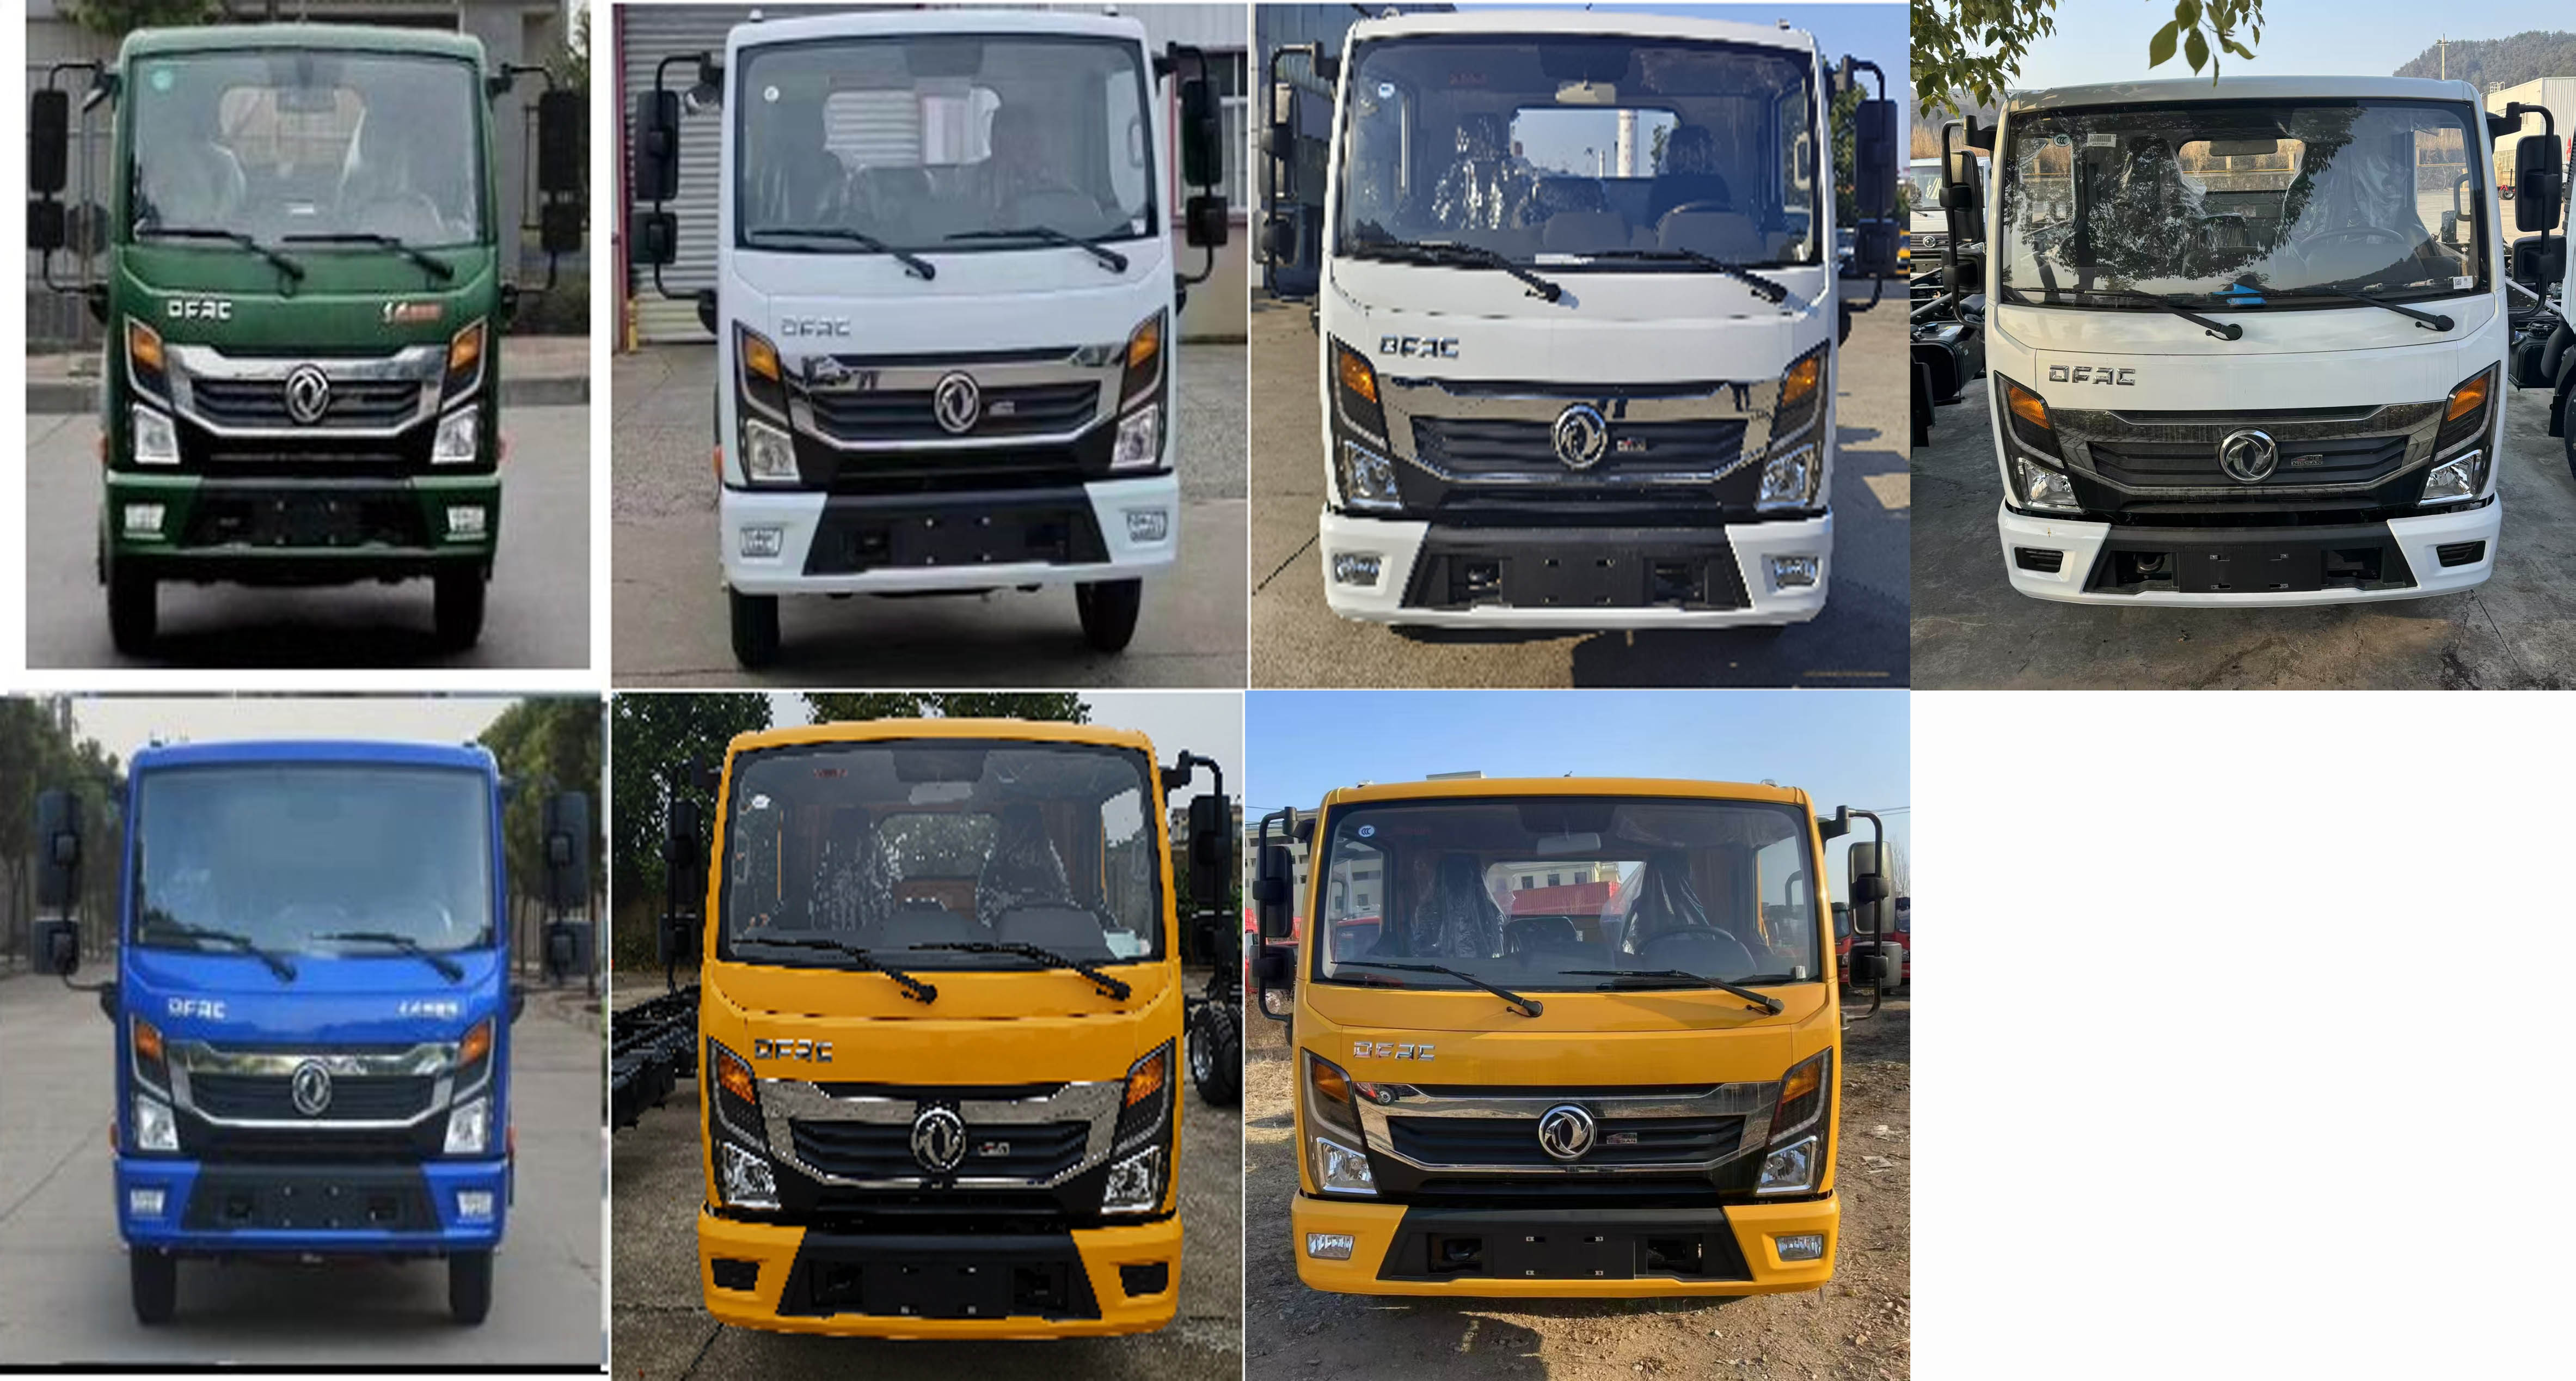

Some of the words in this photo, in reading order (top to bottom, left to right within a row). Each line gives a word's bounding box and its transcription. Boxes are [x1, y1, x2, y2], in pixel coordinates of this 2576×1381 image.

[168, 299, 231, 320] DFAC
[782, 317, 850, 337] DFAC
[1380, 334, 1458, 359] DFAC
[2049, 365, 2135, 386] DFAC
[168, 998, 224, 1018] DFAC
[755, 1039, 832, 1062] DFAC
[1354, 1041, 1435, 1061] DFAC
